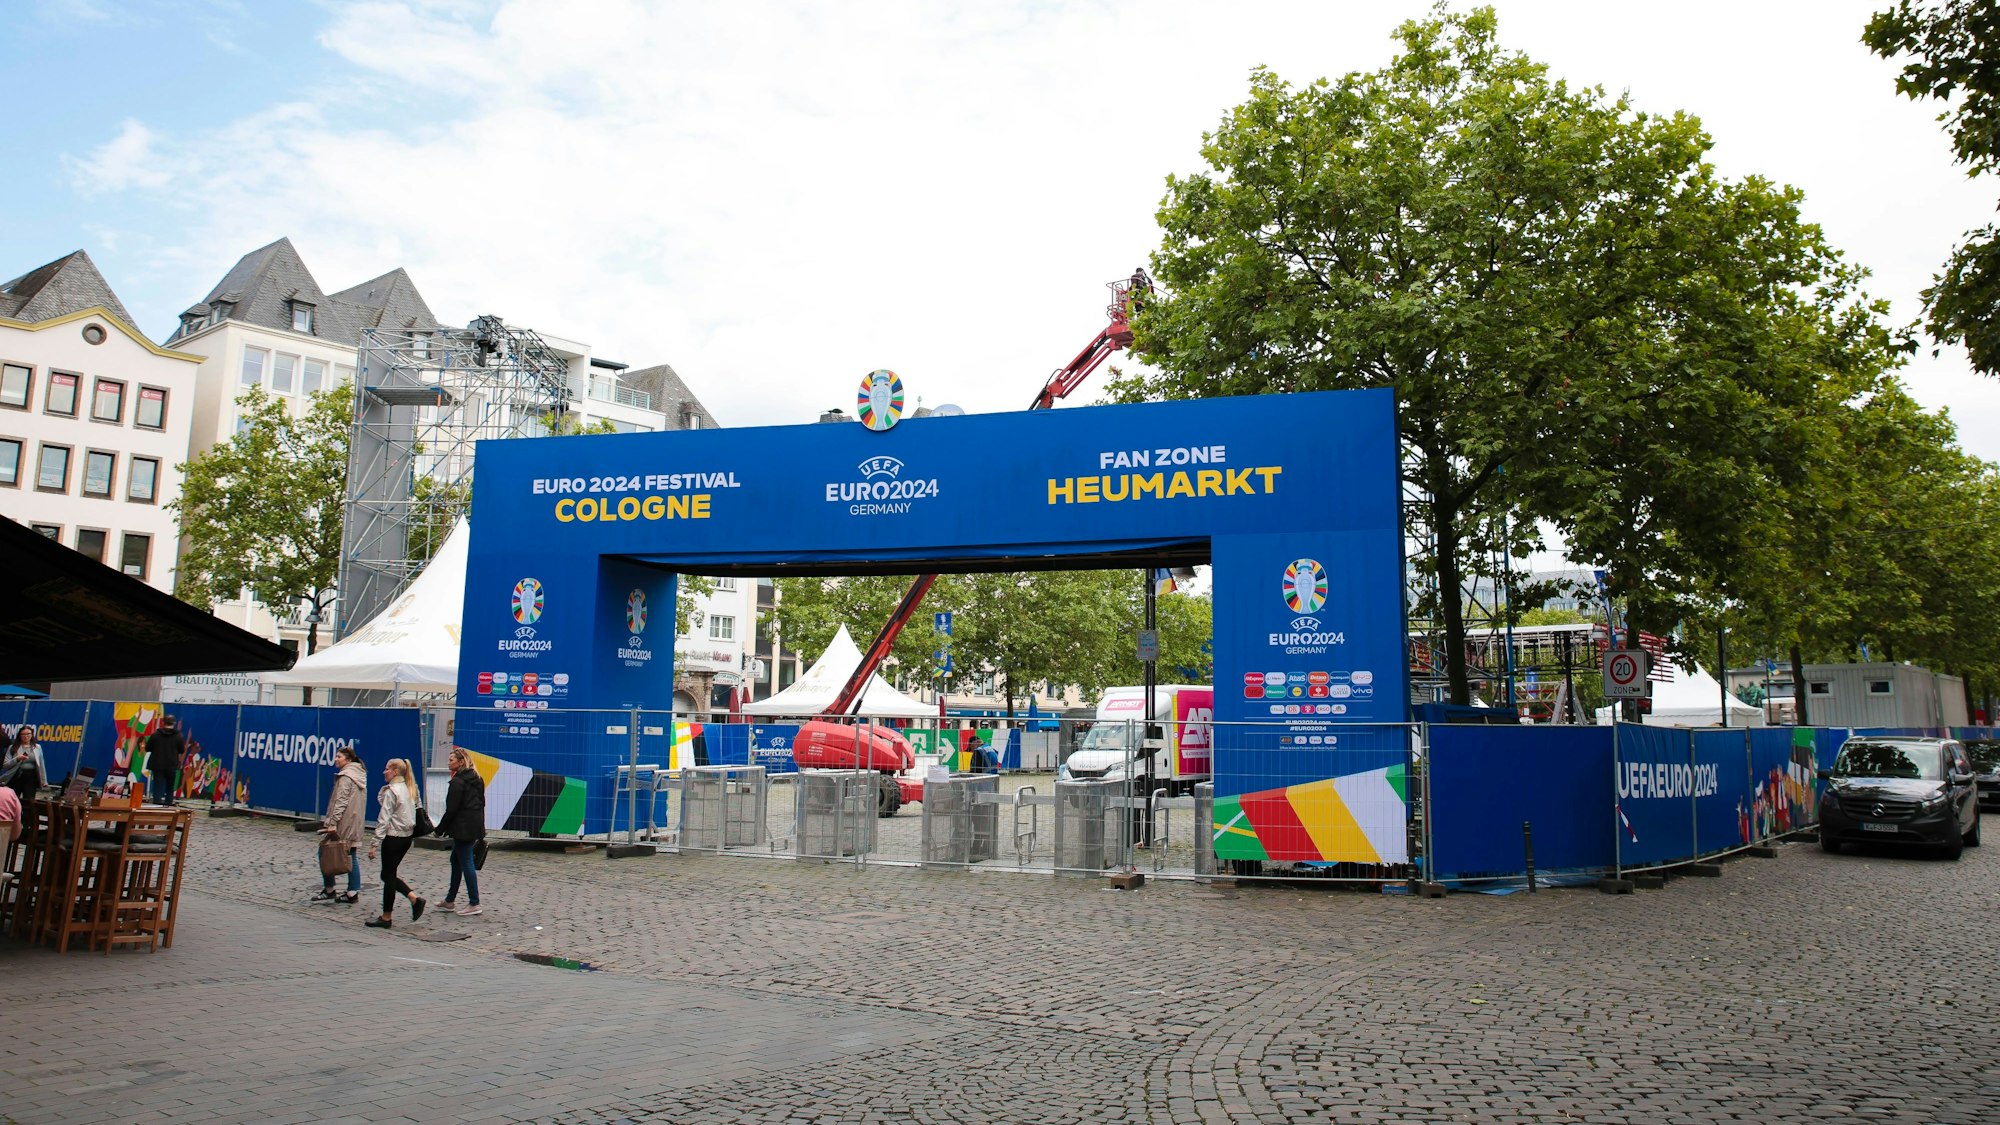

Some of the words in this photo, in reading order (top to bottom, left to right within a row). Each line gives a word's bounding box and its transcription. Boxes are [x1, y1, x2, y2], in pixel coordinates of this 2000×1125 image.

[1100, 450, 1150, 470] FAN
[1154, 445, 1226, 467] ZONE
[860, 460, 900, 476] UEFA
[532, 477, 586, 495] EURO
[589, 475, 641, 492] 2024
[644, 471, 741, 491] FESTIVAL
[825, 478, 940, 502] EURO2024
[1047, 466, 1283, 505] HEUMARKT
[554, 493, 712, 523] COLOGNE
[849, 502, 912, 516] GERMANY
[1291, 619, 1320, 631] UEFA
[515, 627, 536, 638] UEFA
[1268, 632, 1345, 646] EURO2024
[498, 639, 553, 651] EURO2024
[1285, 646, 1327, 655] GERMANY
[508, 651, 540, 659] GERMANY
[1615, 662, 1631, 676] 20
[1613, 686, 1634, 695] ZONE
[1108, 700, 1141, 709] ARNDT
[37, 724, 84, 743] COLOGNE
